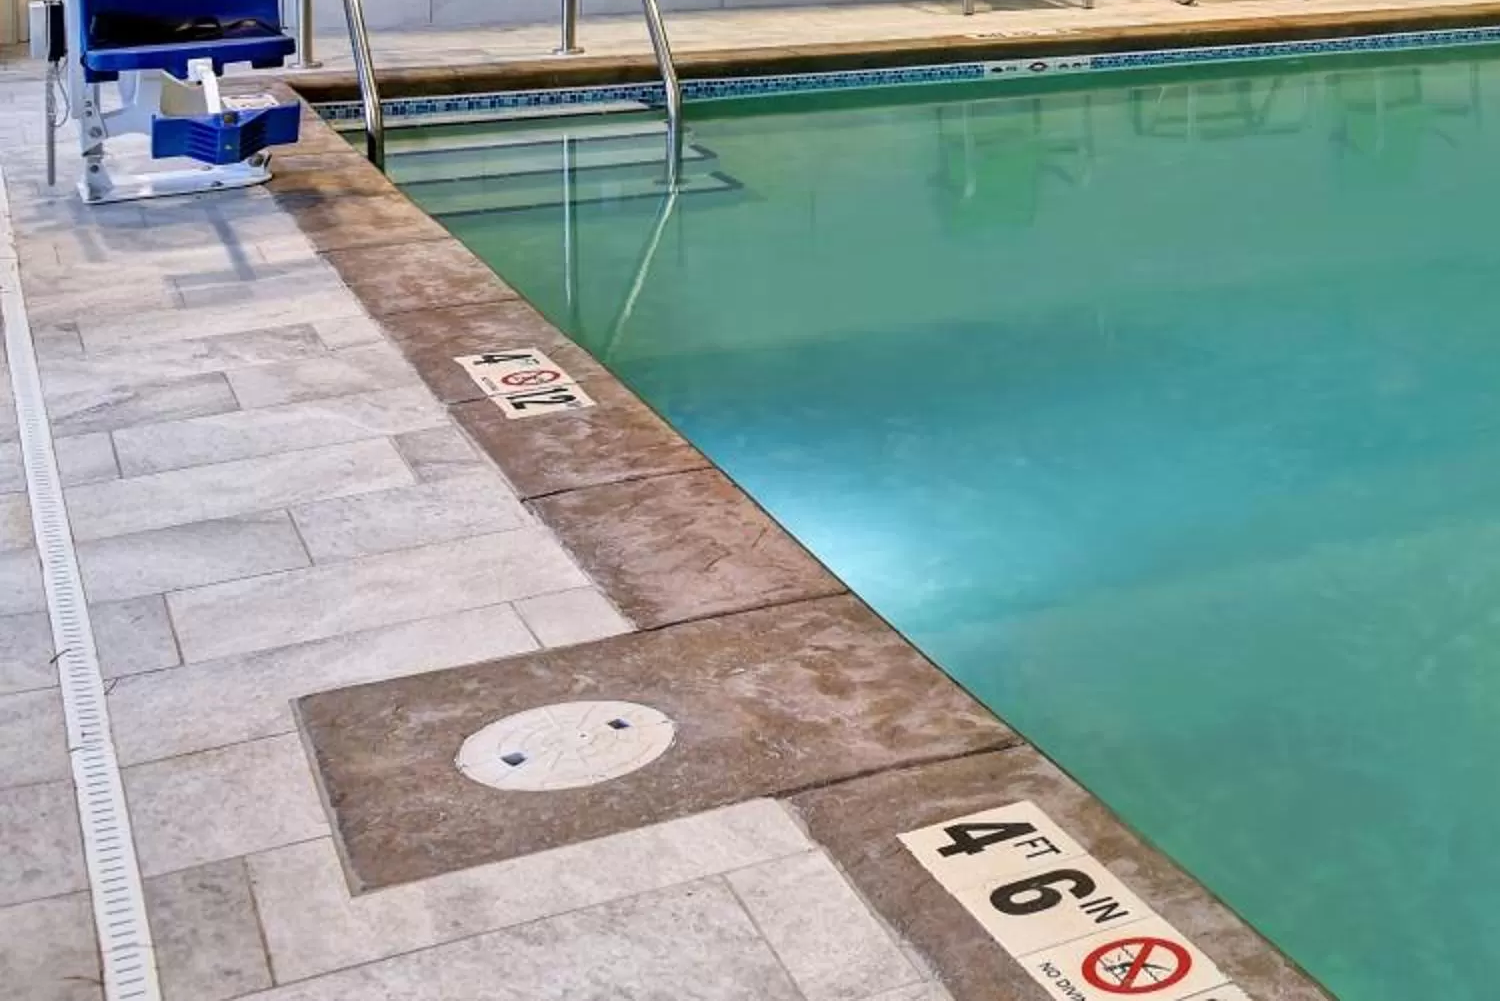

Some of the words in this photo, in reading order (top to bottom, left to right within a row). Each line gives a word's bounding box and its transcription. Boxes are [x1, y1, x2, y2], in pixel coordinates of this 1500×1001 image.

[937, 822, 1037, 857] 4
[1013, 836, 1061, 859] FT
[989, 868, 1097, 916] 6
[1079, 896, 1129, 924] IN
[1038, 962, 1061, 978] NO
